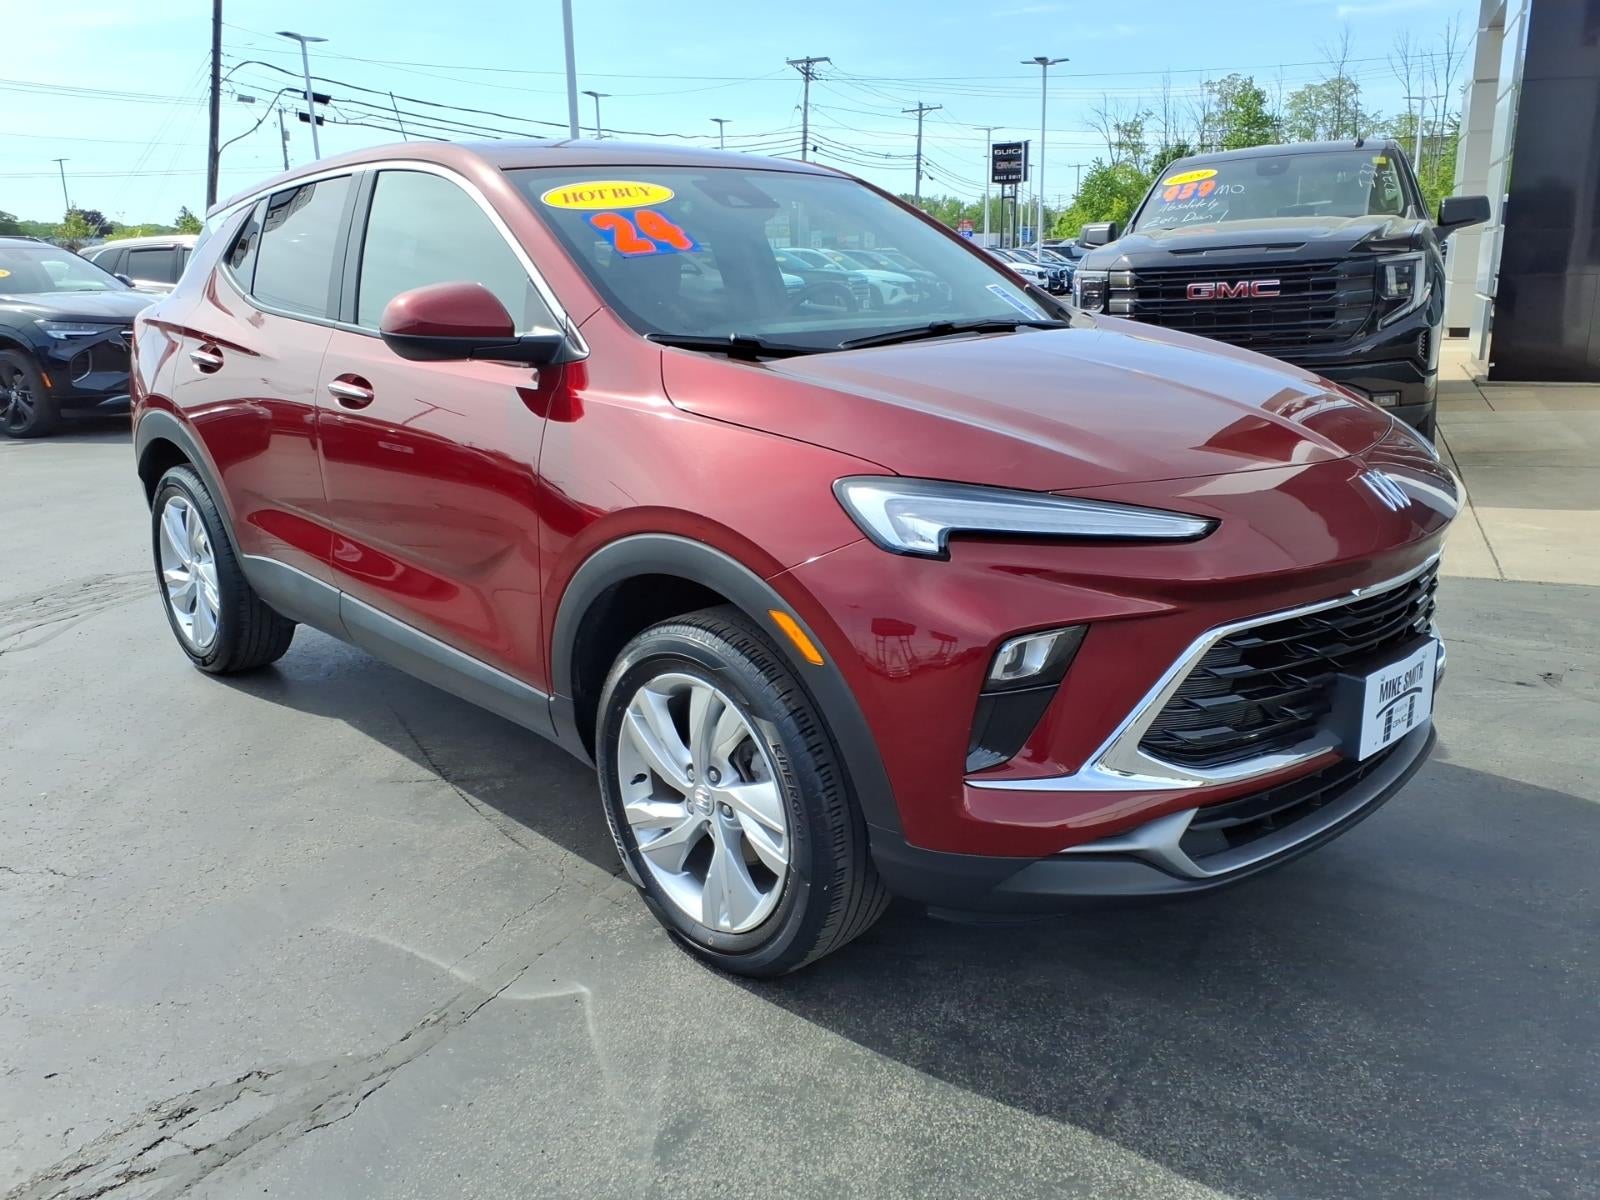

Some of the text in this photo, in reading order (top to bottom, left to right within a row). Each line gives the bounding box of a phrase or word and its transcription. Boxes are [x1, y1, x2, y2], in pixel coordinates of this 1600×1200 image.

[562, 186, 651, 204] HOT BUY
[590, 209, 693, 254] 24
[1186, 279, 1280, 300] GMC
[1379, 661, 1424, 703] MIKE SMITH
[772, 743, 802, 819] KINERGY
